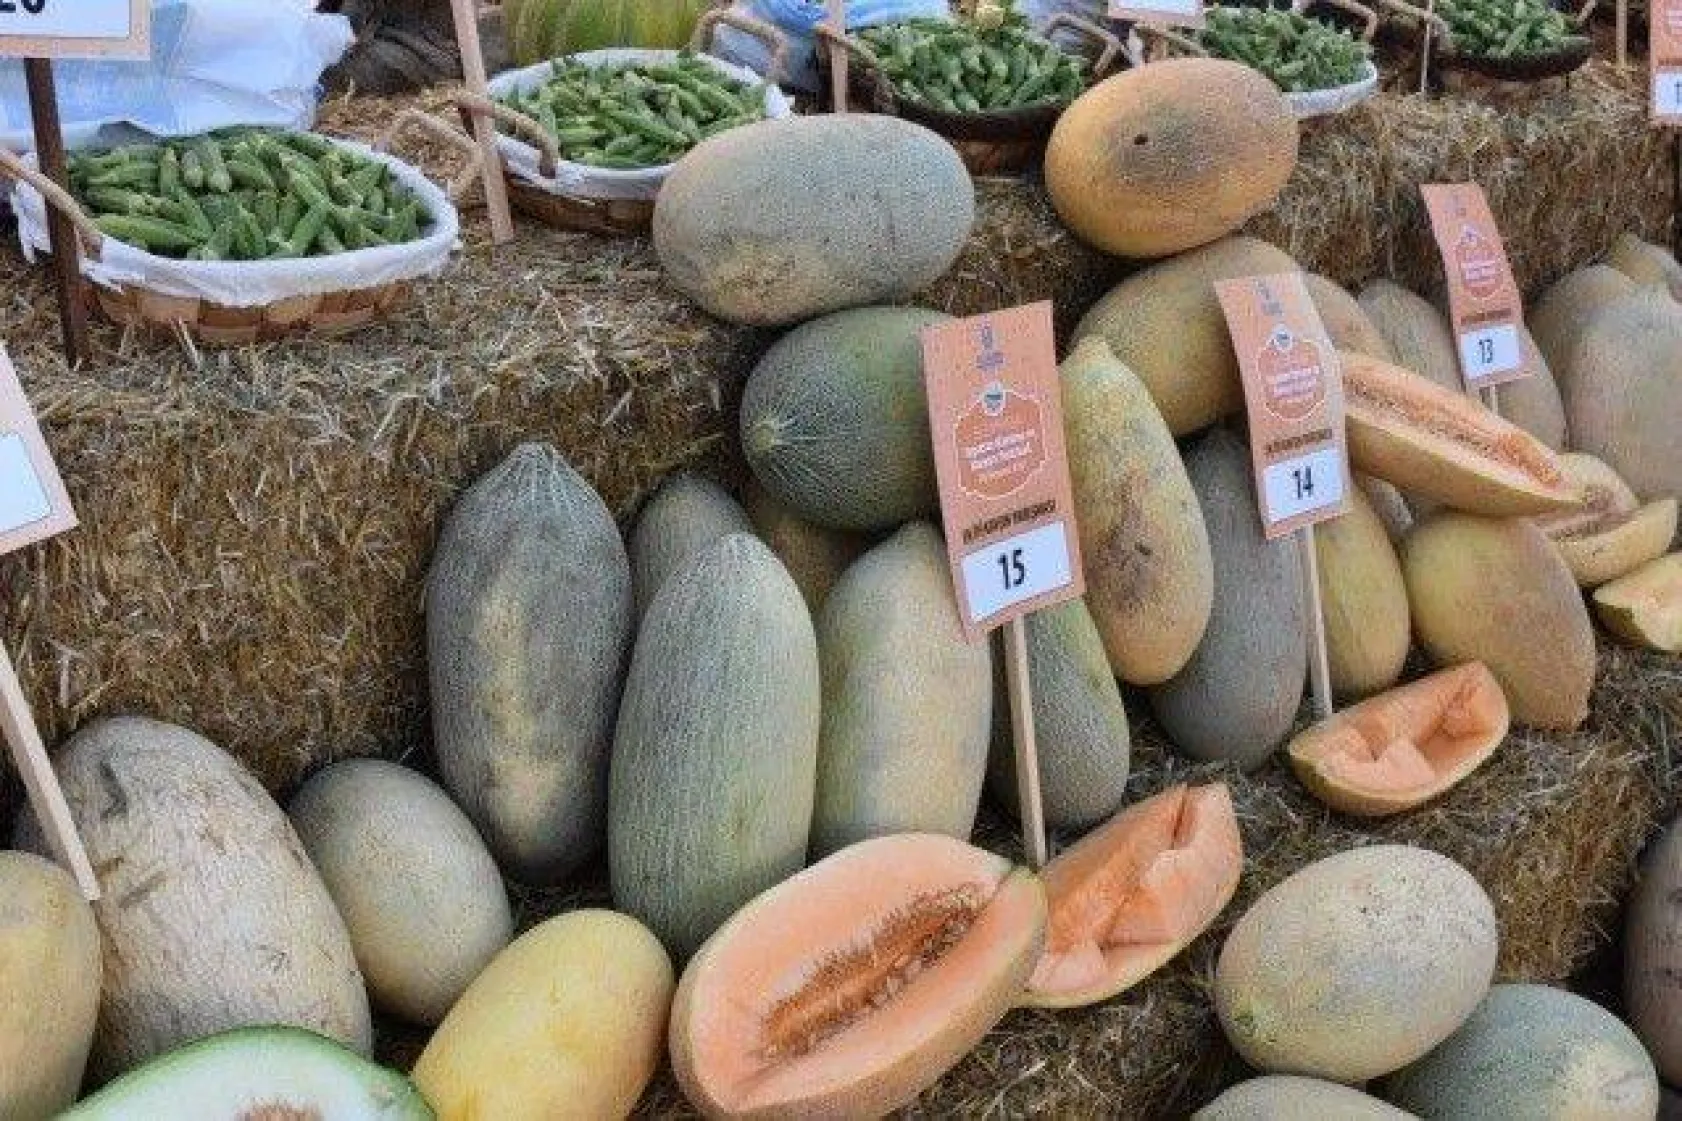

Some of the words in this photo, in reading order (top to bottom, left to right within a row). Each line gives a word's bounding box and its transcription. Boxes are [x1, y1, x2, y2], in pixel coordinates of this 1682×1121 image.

[1673, 81, 1682, 105] 1
[1479, 338, 1493, 364] 13
[1292, 466, 1314, 500] 14
[998, 548, 1025, 590] 15
